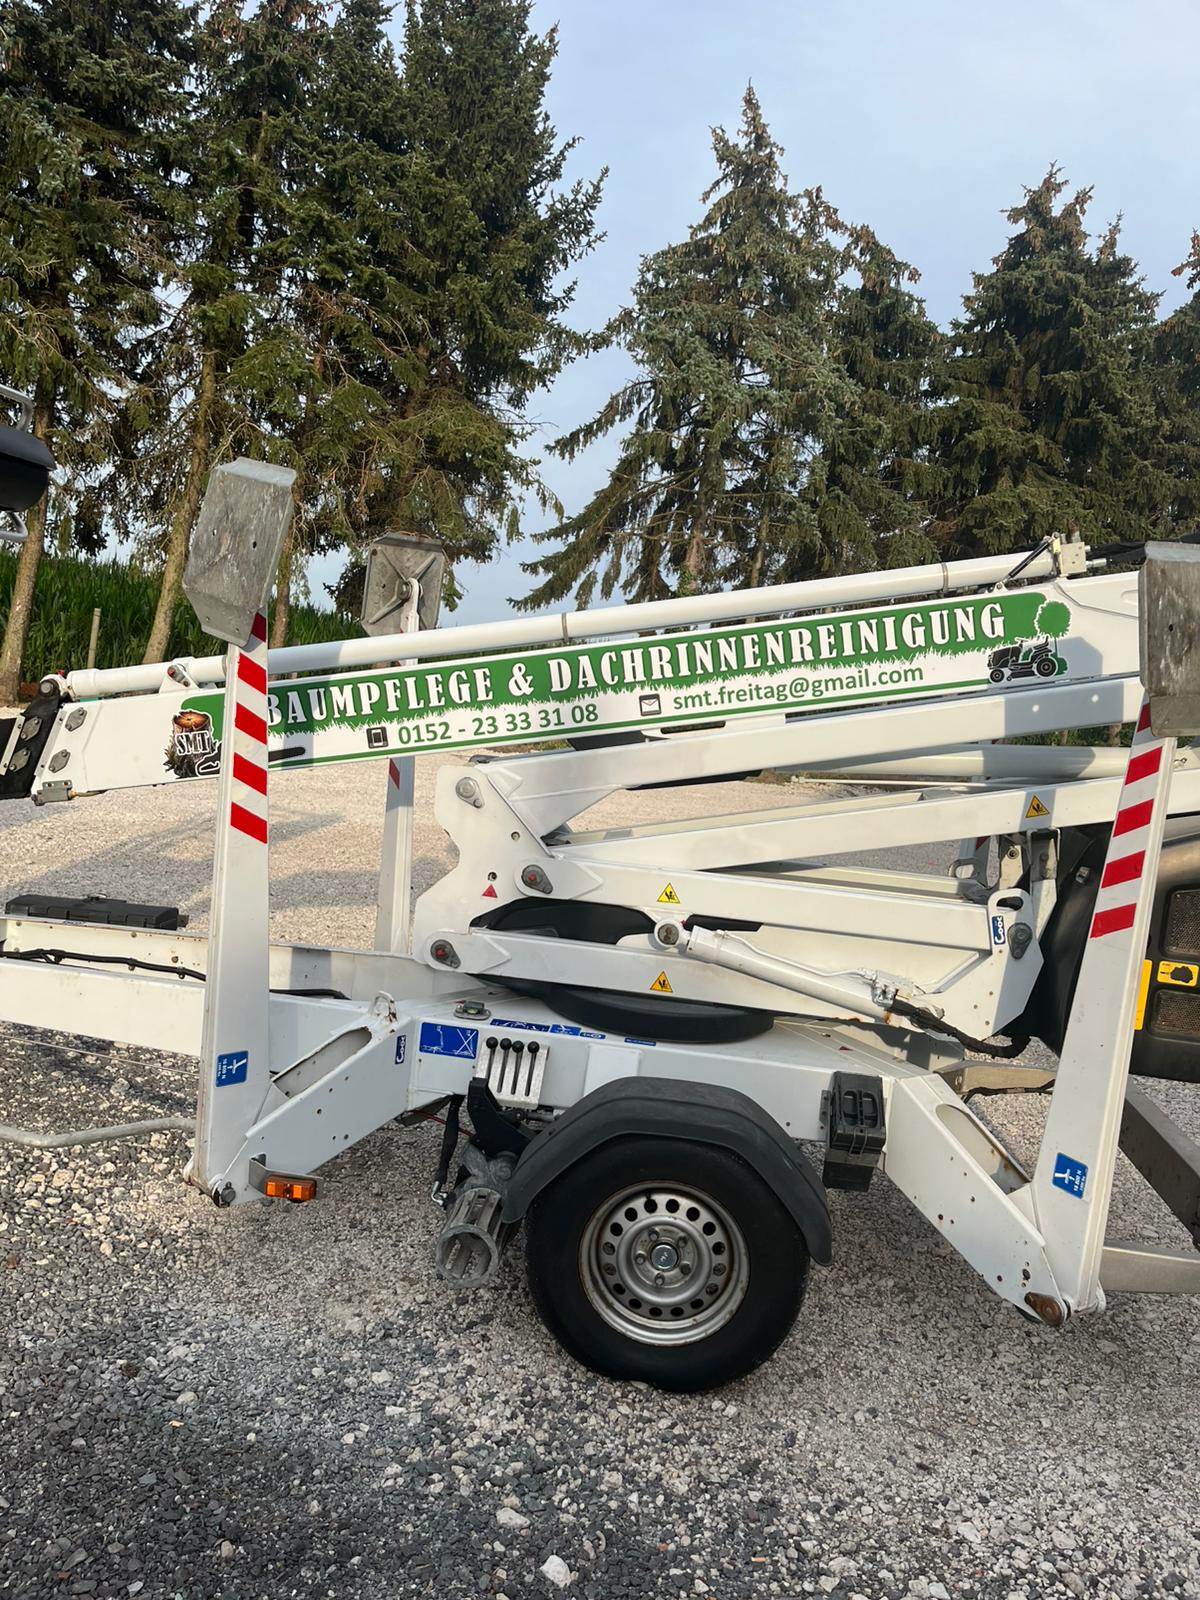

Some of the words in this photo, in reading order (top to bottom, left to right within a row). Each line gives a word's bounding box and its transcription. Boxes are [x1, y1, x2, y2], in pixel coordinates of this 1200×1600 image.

[268, 667, 493, 726] BAUMPFLEGE
[508, 663, 536, 697] &
[547, 602, 1006, 692] DACHRINNENREINIGUNG
[673, 665, 924, 710] smt.freitag@gmail.com
[175, 730, 211, 755] SMT
[398, 721, 452, 744] 0152
[473, 717, 499, 736] 23
[506, 713, 532, 732] 33
[539, 709, 566, 728] 31
[572, 703, 599, 724] 08
